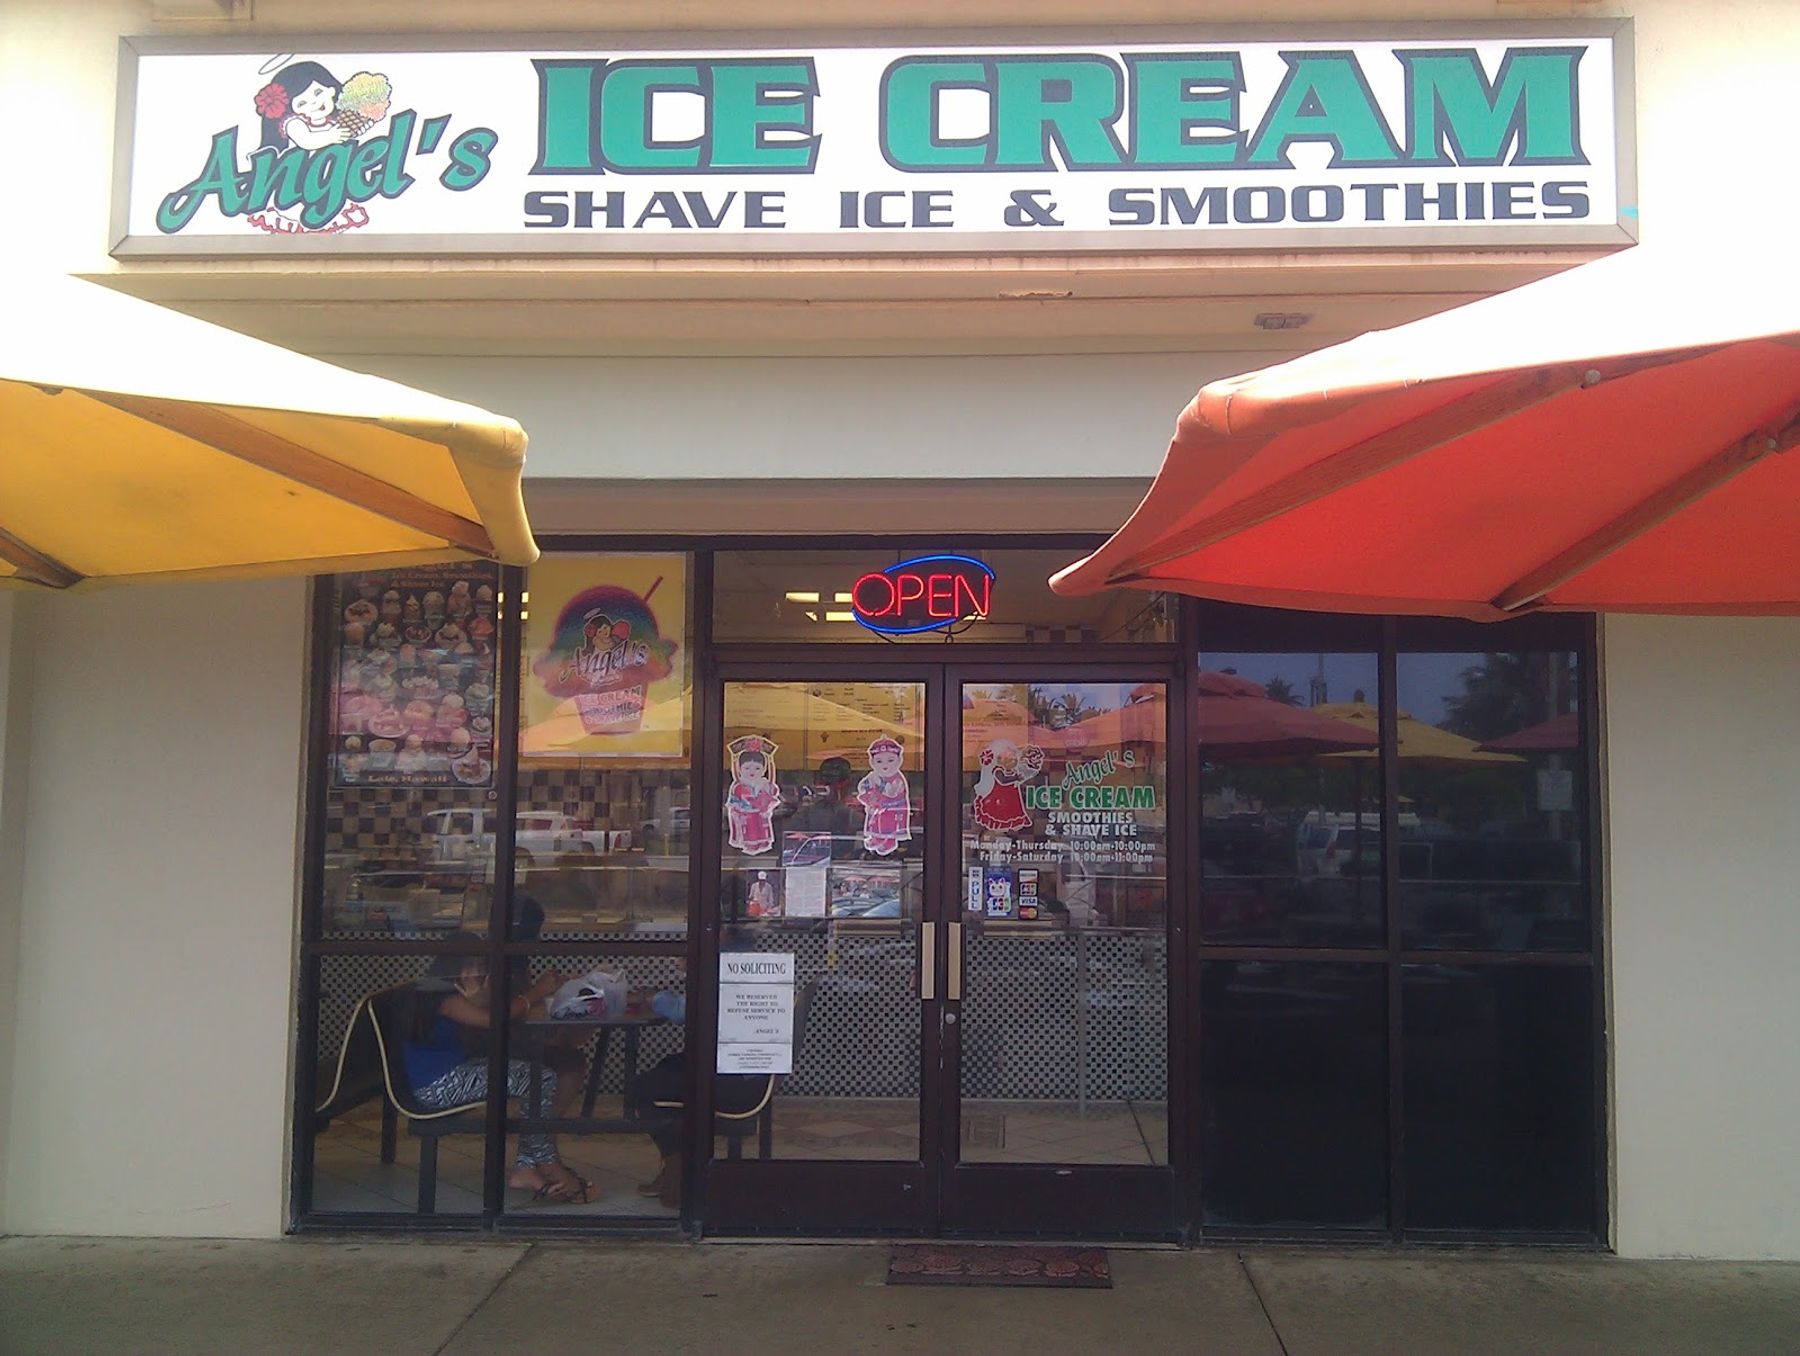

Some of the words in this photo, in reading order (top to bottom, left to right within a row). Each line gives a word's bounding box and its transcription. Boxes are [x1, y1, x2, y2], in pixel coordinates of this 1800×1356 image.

[528, 56, 823, 175] ICE
[879, 46, 1592, 173] CREAM
[156, 108, 498, 234] Angel's
[523, 190, 786, 228] SHAVE
[840, 190, 954, 228] ICE
[1004, 189, 1065, 227] &
[1108, 181, 1591, 226] SMOOTHIES
[853, 572, 990, 617] OPEN
[559, 641, 648, 684] Angel's
[1062, 750, 1136, 790] Angel's
[1026, 785, 1062, 809] ICE
[1070, 785, 1156, 810] CREAM
[1045, 825, 1057, 836] &
[1062, 824, 1110, 836] SHAVE
[1115, 824, 1138, 836] ICE
[1048, 812, 1134, 825] SMOOTHIES
[971, 881, 980, 909] PULL
[727, 962, 739, 975] NO
[740, 962, 786, 975] SOLICITING
